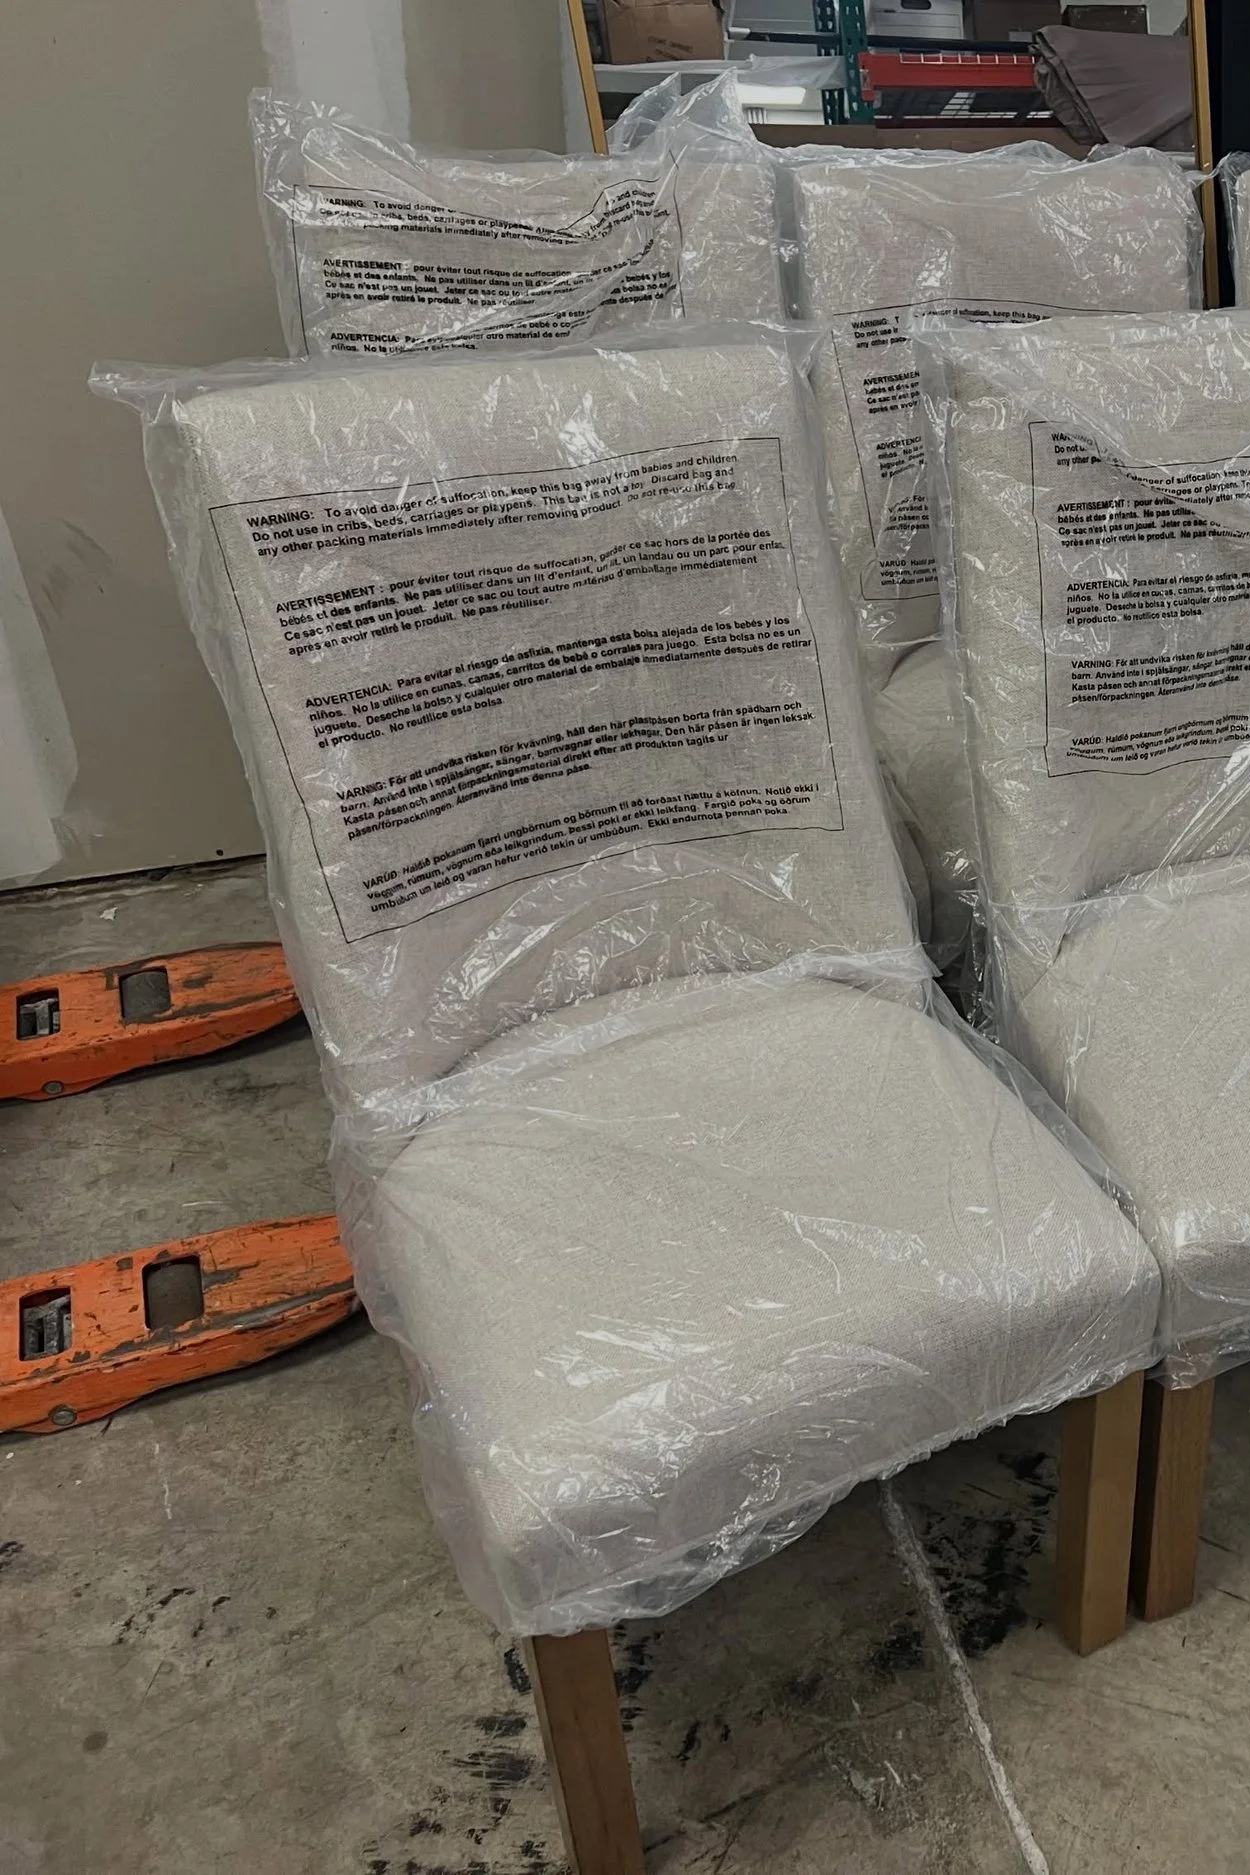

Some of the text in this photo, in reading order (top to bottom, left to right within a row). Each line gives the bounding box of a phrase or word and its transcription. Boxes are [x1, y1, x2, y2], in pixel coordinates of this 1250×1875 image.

[401, 224, 442, 233] materials
[437, 265, 460, 273] éviter
[464, 267, 481, 275] tout
[439, 277, 454, 285] pas
[246, 510, 314, 526] WARNING:
[324, 507, 340, 517] To
[344, 505, 377, 515] avoid
[511, 486, 536, 494] keep
[539, 483, 559, 492] this
[584, 474, 611, 487] away
[641, 463, 672, 473] babies
[676, 457, 693, 466] and
[258, 547, 277, 557] any
[282, 541, 312, 552] other
[316, 535, 364, 549] packing
[368, 527, 422, 542] materials
[426, 517, 494, 533] immediately
[498, 514, 522, 523] after
[526, 509, 577, 520] removing
[1193, 531, 1207, 539] pas
[389, 579, 414, 592] pour
[418, 574, 449, 584] éviter
[453, 569, 474, 579] tout
[478, 566, 512, 575] risque
[533, 556, 596, 569] suffocation,
[665, 538, 688, 546] hors
[707, 534, 715, 542] la
[718, 530, 749, 542] portée
[753, 529, 770, 537] des
[1179, 575, 1203, 584] riesgo
[1098, 592, 1110, 600] No
[1145, 601, 1166, 609] bolsa
[306, 683, 392, 707] ADVERTENCIA:
[397, 677, 421, 687] Para
[424, 668, 451, 681] evitar
[455, 663, 464, 673] el
[467, 658, 498, 671] riesgo
[501, 654, 514, 662] de
[517, 646, 553, 659] asfixia,
[556, 637, 607, 651] mantenga
[610, 633, 631, 642] esta
[632, 629, 658, 637] bolsa
[662, 626, 697, 637] alejada
[734, 619, 762, 628] bebés
[1071, 680, 1137, 691] Kasta påsen och
[318, 738, 328, 748] el
[331, 730, 384, 746] producto.
[389, 723, 403, 732] No
[406, 711, 447, 727] reutilice
[451, 705, 471, 716] esta
[388, 775, 406, 786] För
[409, 769, 422, 780] att
[424, 757, 463, 775] undvika
[464, 749, 496, 761] risken
[499, 744, 513, 753] för
[516, 733, 563, 749] kvävning,
[566, 726, 584, 736] håll
[628, 716, 679, 727] plastpåsen
[683, 712, 709, 720] borta
[712, 708, 732, 716] från
[736, 705, 780, 715] spädbarn
[784, 701, 801, 709] och
